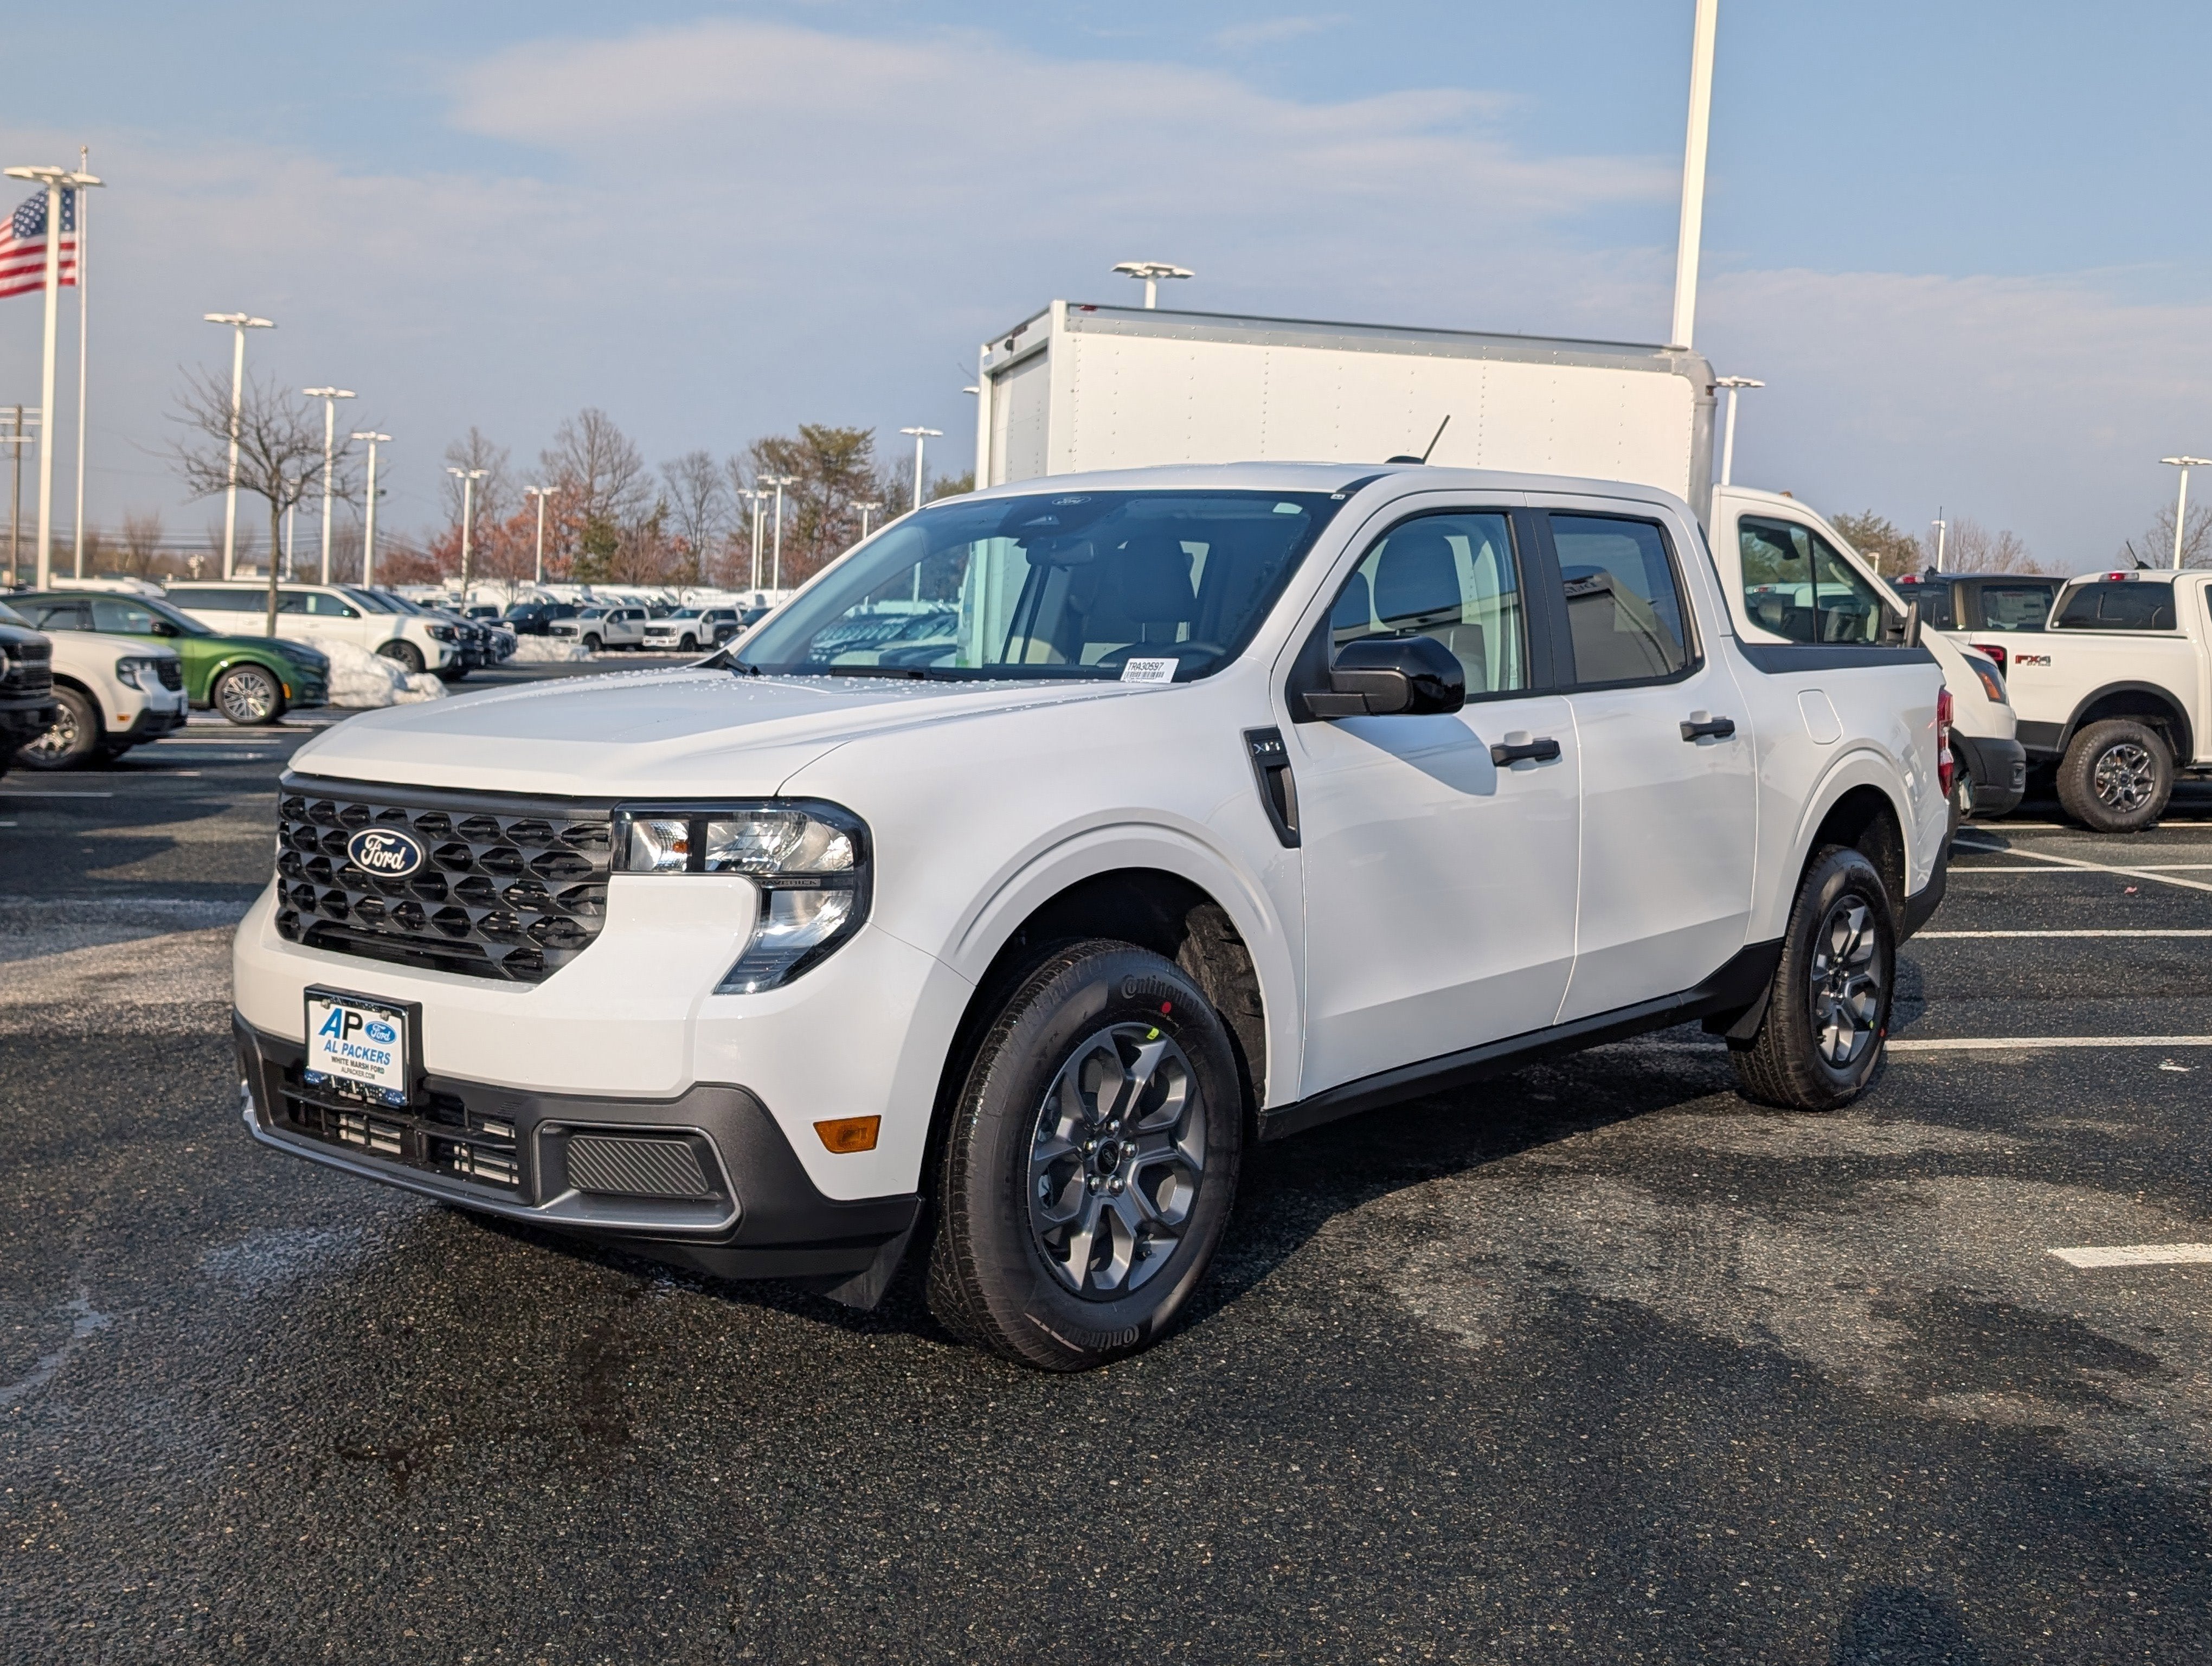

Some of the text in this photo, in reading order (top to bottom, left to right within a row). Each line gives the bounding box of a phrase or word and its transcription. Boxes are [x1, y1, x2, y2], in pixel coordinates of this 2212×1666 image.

[1128, 662, 1165, 671] TRA30597
[2015, 655, 2051, 665] FX4
[361, 834, 407, 870] Ford
[318, 1008, 363, 1041] AP
[371, 1024, 391, 1041] Ford
[324, 1040, 391, 1066] AL PACKERS
[331, 1056, 385, 1074] WHITE MARSH FORD
